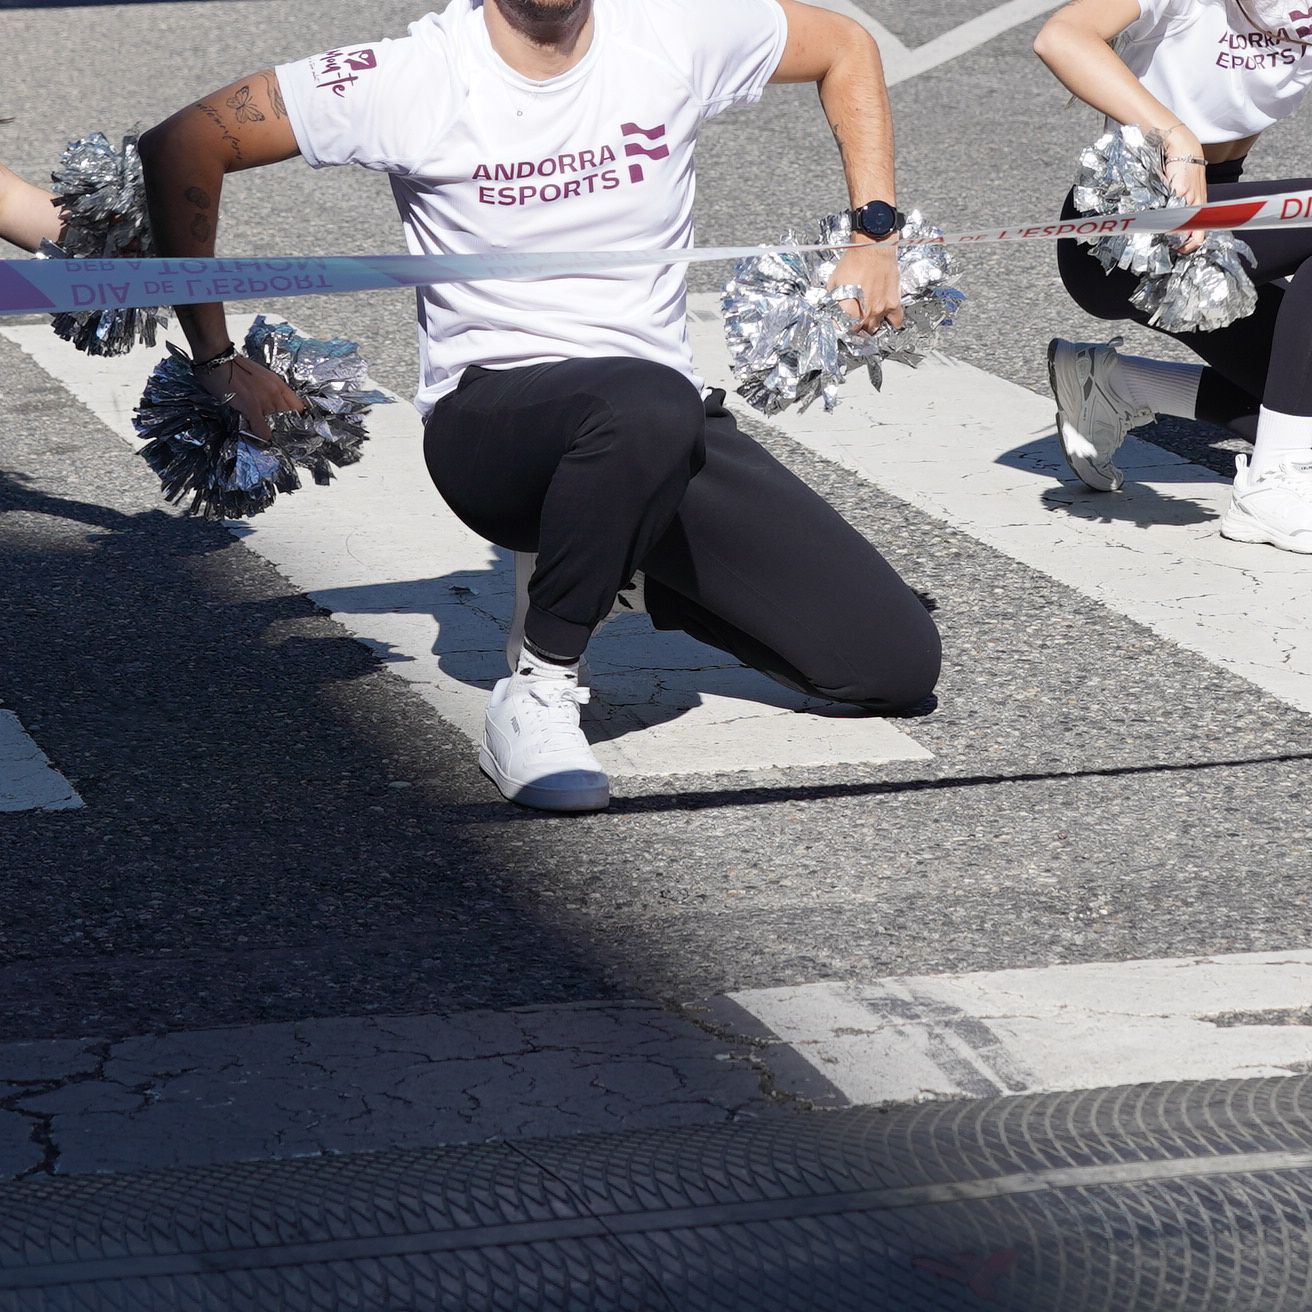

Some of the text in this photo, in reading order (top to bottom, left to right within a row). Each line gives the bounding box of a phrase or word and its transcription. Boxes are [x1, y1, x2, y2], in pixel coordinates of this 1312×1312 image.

[471, 144, 616, 181] ANDORRA
[478, 169, 620, 206] ESPORTS
[999, 218, 1136, 240] L'ESPORT
